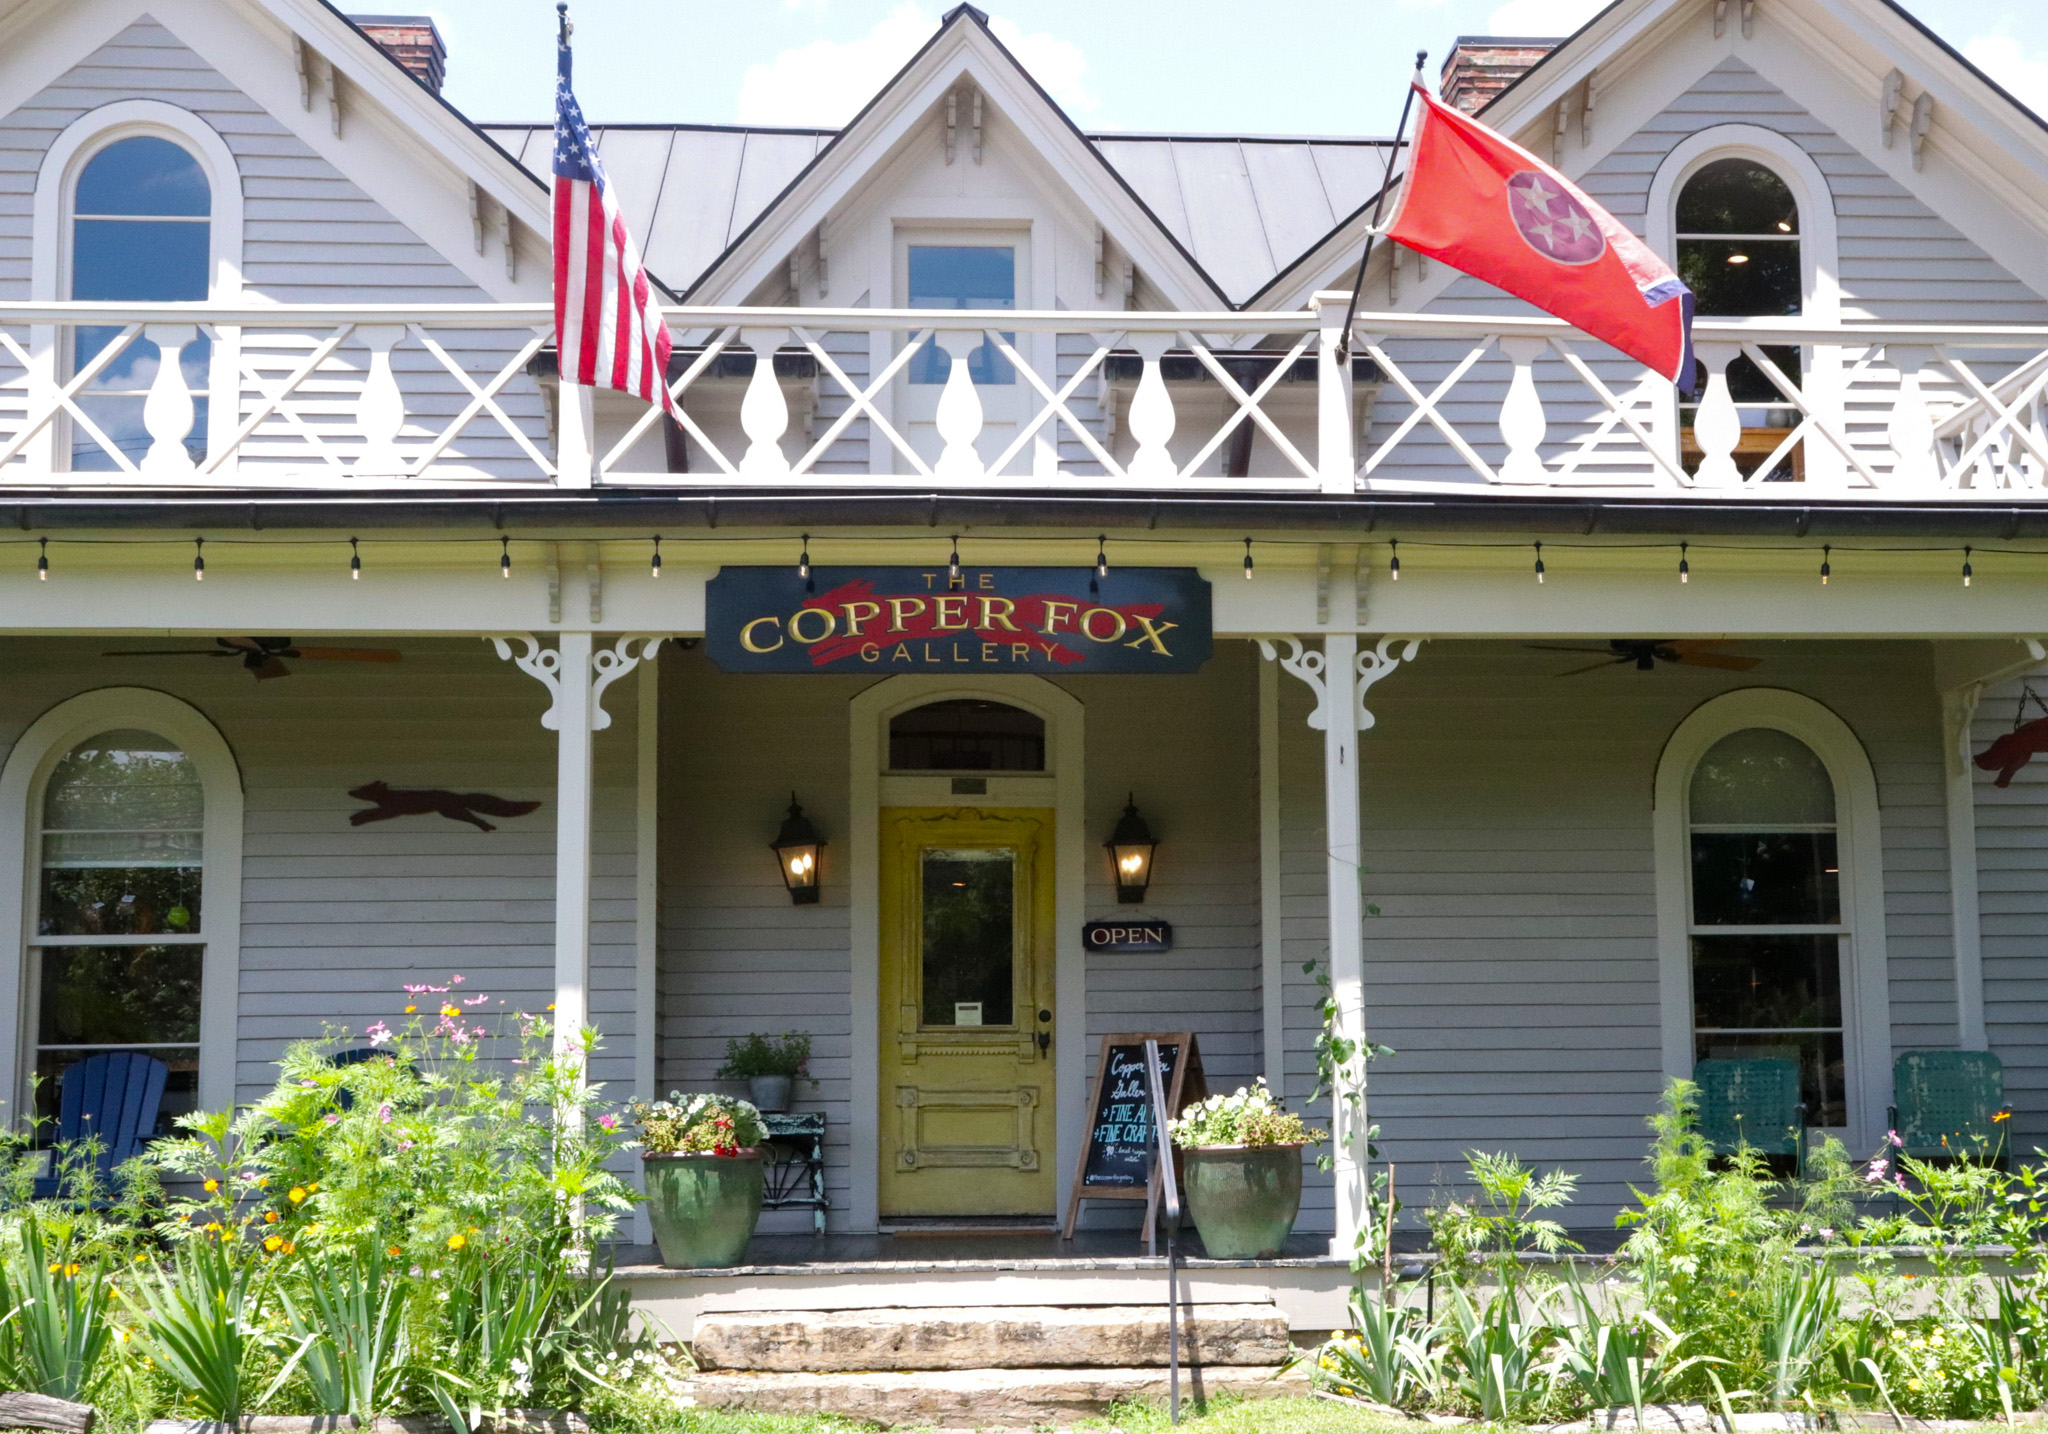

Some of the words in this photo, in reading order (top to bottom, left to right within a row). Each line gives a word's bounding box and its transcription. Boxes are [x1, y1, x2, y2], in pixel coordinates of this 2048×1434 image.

[922, 573, 995, 590] THE
[739, 596, 1022, 654] COPPER
[1037, 600, 1179, 657] FOX
[860, 642, 1059, 663] GALLERY
[1090, 927, 1163, 945] OPEN
[1111, 1053, 1146, 1079] Copper
[1111, 1079, 1147, 1100] Galler
[1109, 1103, 1135, 1122] FINE
[1098, 1124, 1123, 1142] FINE
